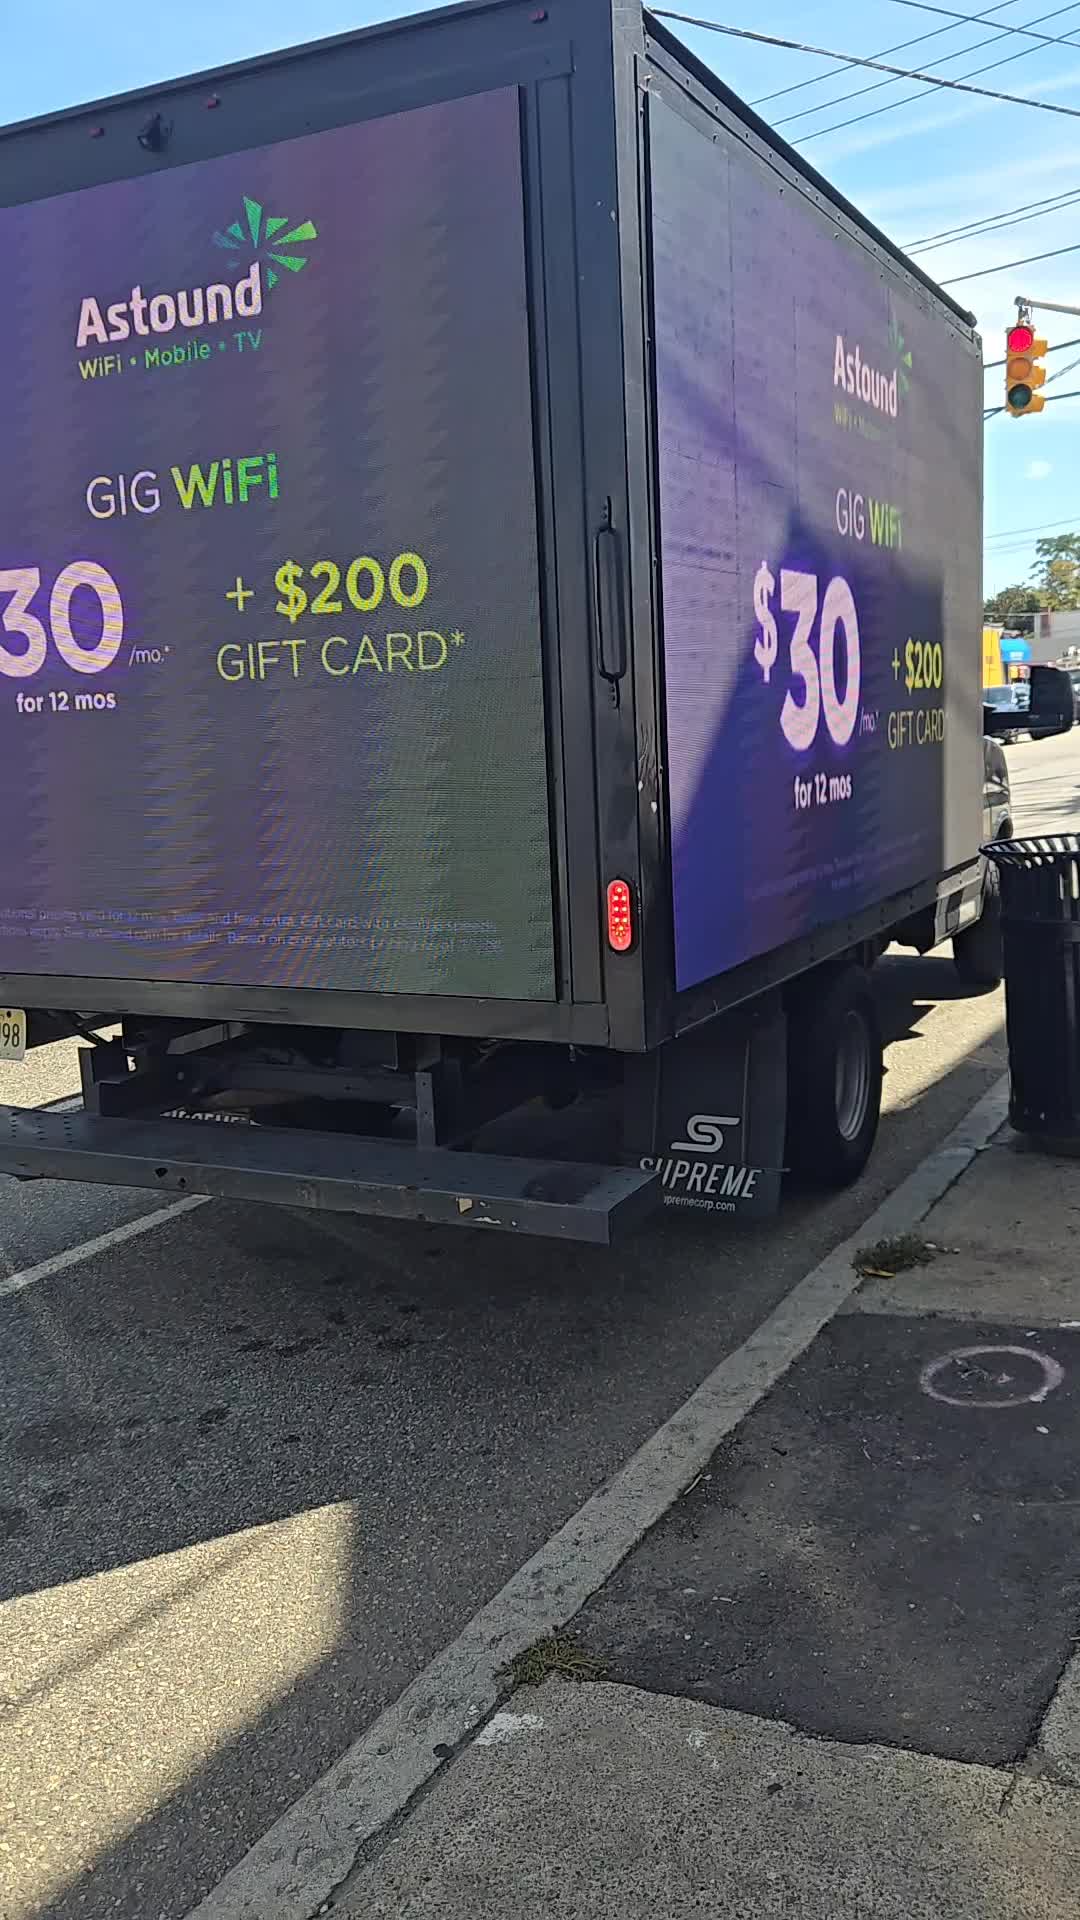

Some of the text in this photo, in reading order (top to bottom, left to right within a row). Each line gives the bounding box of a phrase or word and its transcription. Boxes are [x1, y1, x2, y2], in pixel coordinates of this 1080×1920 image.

[76, 261, 263, 348] Astound
[78, 329, 263, 380] WiFi Mobile TV
[833, 335, 898, 418] Astound
[85, 453, 281, 519] GIG WiFi
[835, 487, 903, 550] GIG WiFi
[274, 552, 430, 624] $200
[216, 639, 307, 681] GIFT
[753, 560, 861, 752] $30
[905, 636, 943, 696] $200
[15, 691, 117, 714] for 12 mos
[887, 710, 914, 750] GIFT
[794, 771, 853, 810] for 12 mos
[0, 1022, 20, 1048] 98
